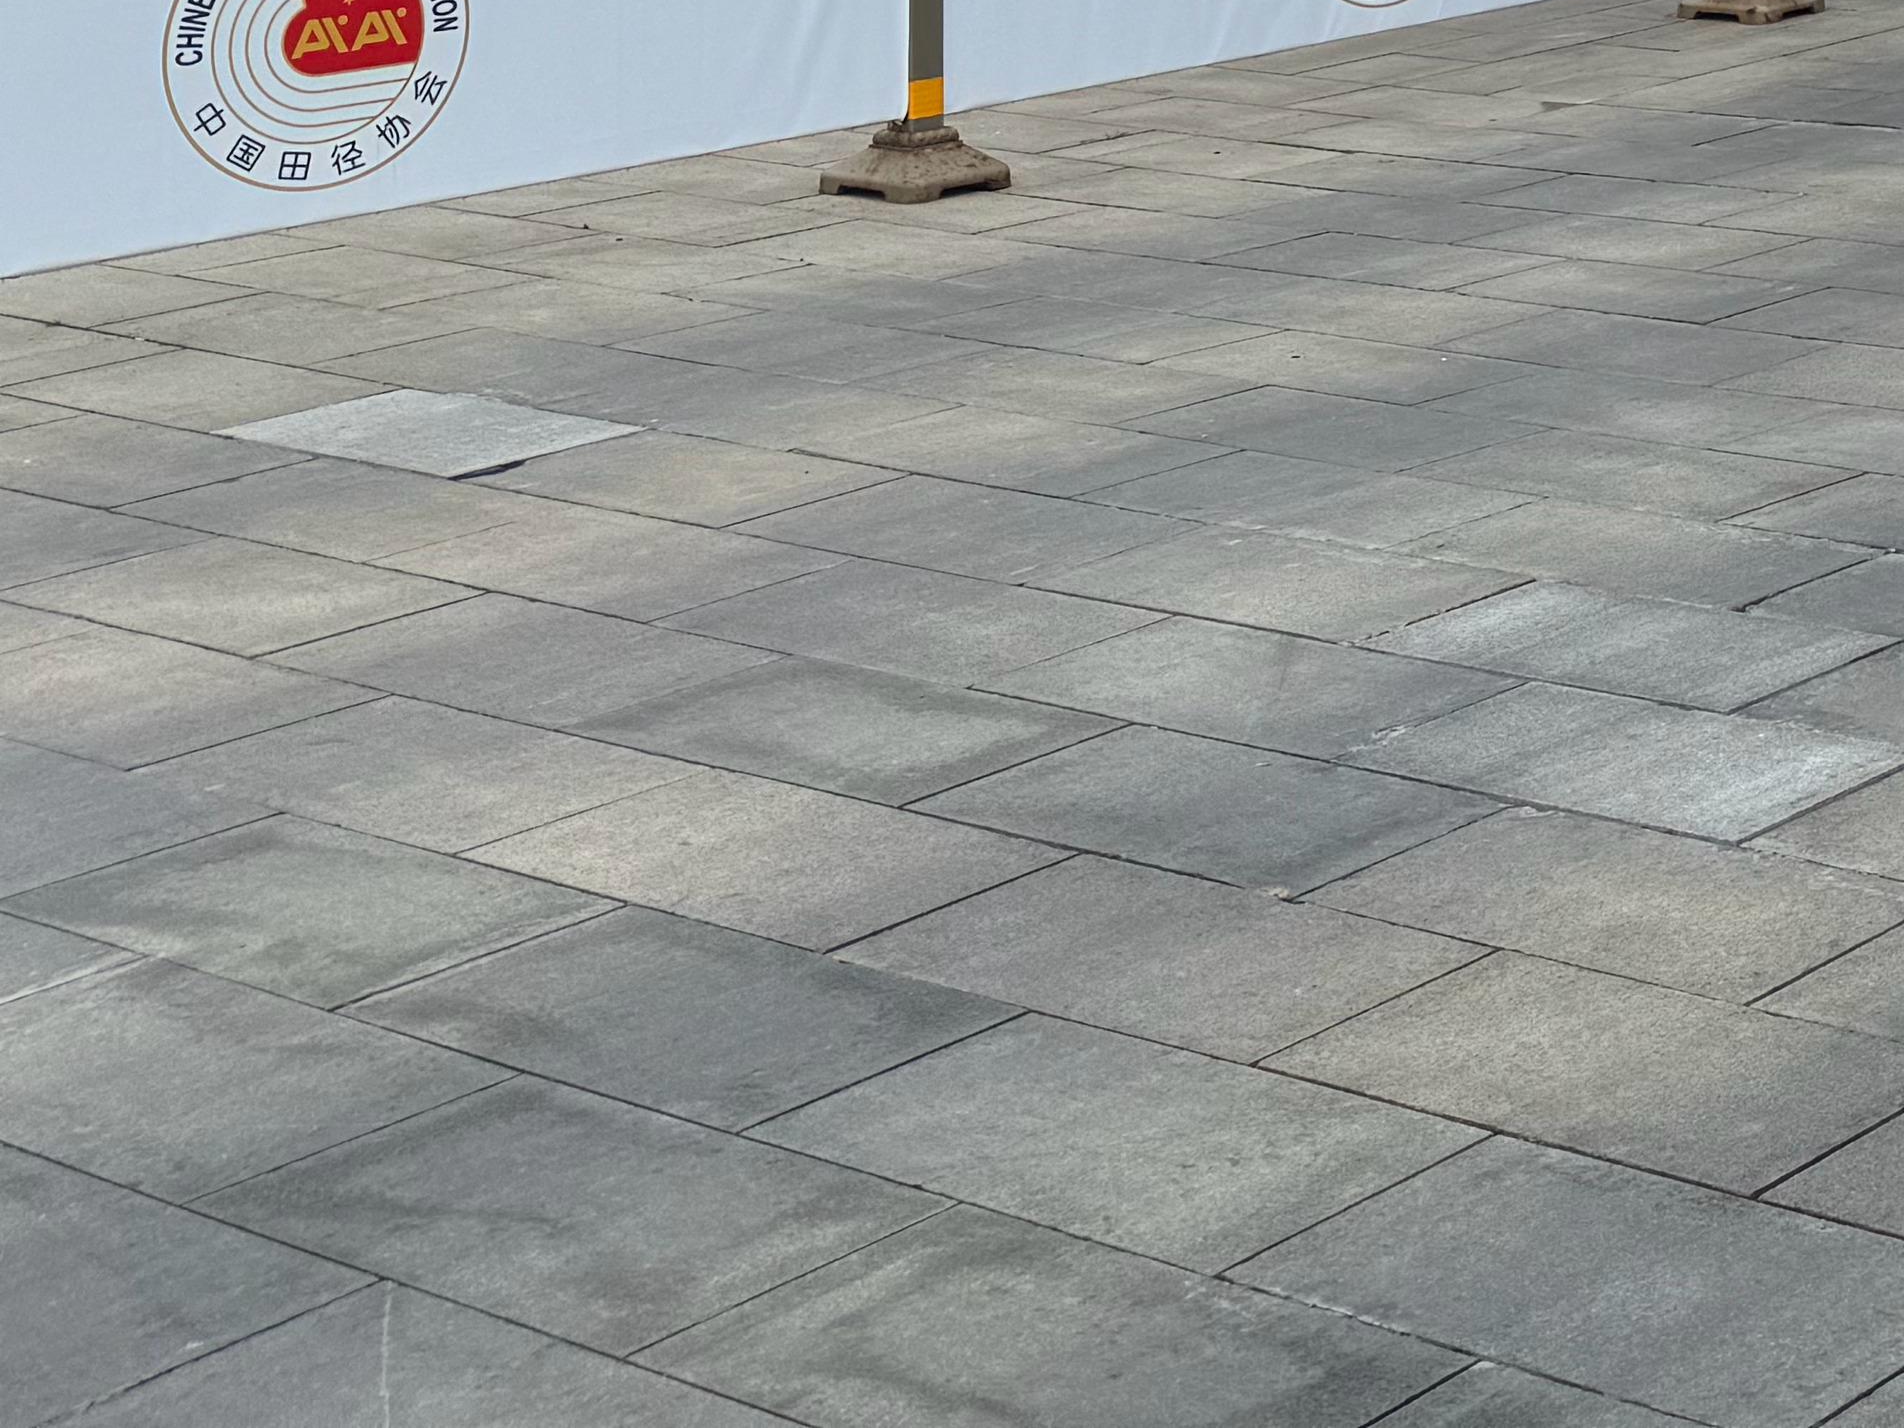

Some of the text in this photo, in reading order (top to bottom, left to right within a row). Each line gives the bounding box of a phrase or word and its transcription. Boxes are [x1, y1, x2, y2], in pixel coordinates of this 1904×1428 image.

[193, 70, 448, 180] 中国田径协会
